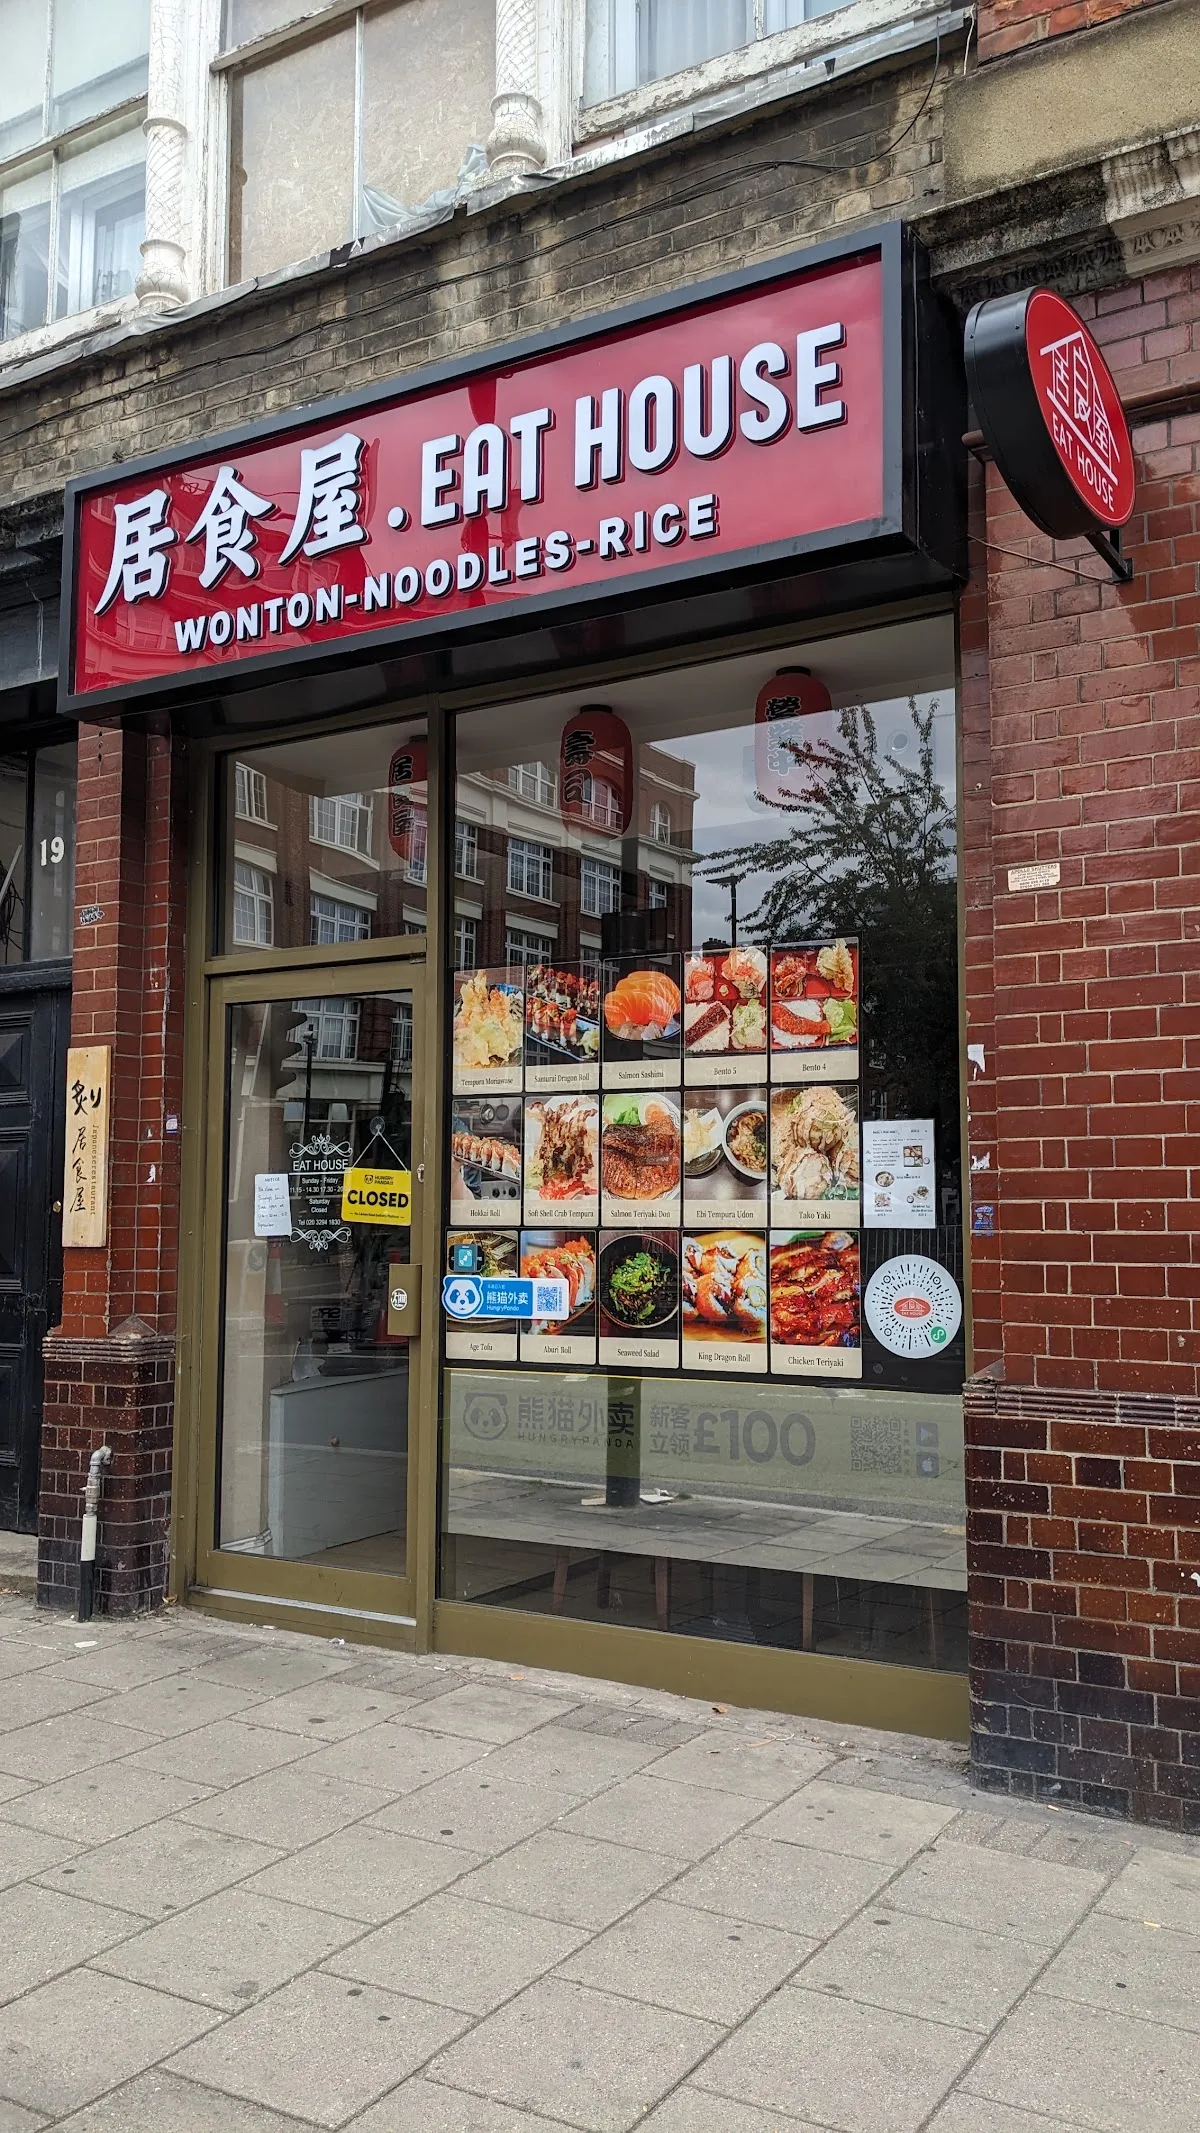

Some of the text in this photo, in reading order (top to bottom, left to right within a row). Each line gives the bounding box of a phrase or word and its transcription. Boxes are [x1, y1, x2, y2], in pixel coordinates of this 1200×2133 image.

[575, 322, 847, 491] HOUSE
[1053, 412, 1115, 513] EAT HOUSE
[94, 432, 366, 616] 居食屋
[173, 493, 718, 654] WONTON-NOODLES-RICE
[40, 836, 65, 867] 19
[713, 1067, 737, 1076] Bento 5
[802, 1063, 826, 1072] Bento 4
[534, 1073, 590, 1083] Samurai Dragon Roll
[640, 1070, 664, 1078] Sashimi
[461, 1079, 485, 1087] Tempura
[71, 1079, 102, 1116] 炙り
[293, 1159, 349, 1171] EAT HOUSE
[347, 1189, 409, 1208] CLOSED
[470, 1209, 501, 1217] Hokkai Roll
[528, 1209, 594, 1219] Soft Shell Crab Tempura
[611, 1210, 671, 1219] Salmon Teriyaki Don
[696, 1210, 707, 1218] Ebi
[708, 1211, 736, 1220] Tempura
[799, 1211, 831, 1220] Tako Yaki
[486, 1291, 528, 1305] 熊猫外卖
[469, 1343, 493, 1352] Age Tofu
[543, 1346, 572, 1354] Aburi Roll
[617, 1348, 660, 1358] Seaweed Salad
[698, 1352, 751, 1363] King Dragon Roll
[788, 1356, 844, 1368] Chicken Teriyaki
[518, 1395, 635, 1437] 熊猫外卖
[650, 1405, 690, 1430] 新客
[517, 1433, 635, 1449] HUNGRYPANDA
[650, 1431, 690, 1457] 立领
[693, 1409, 816, 1467] £100
